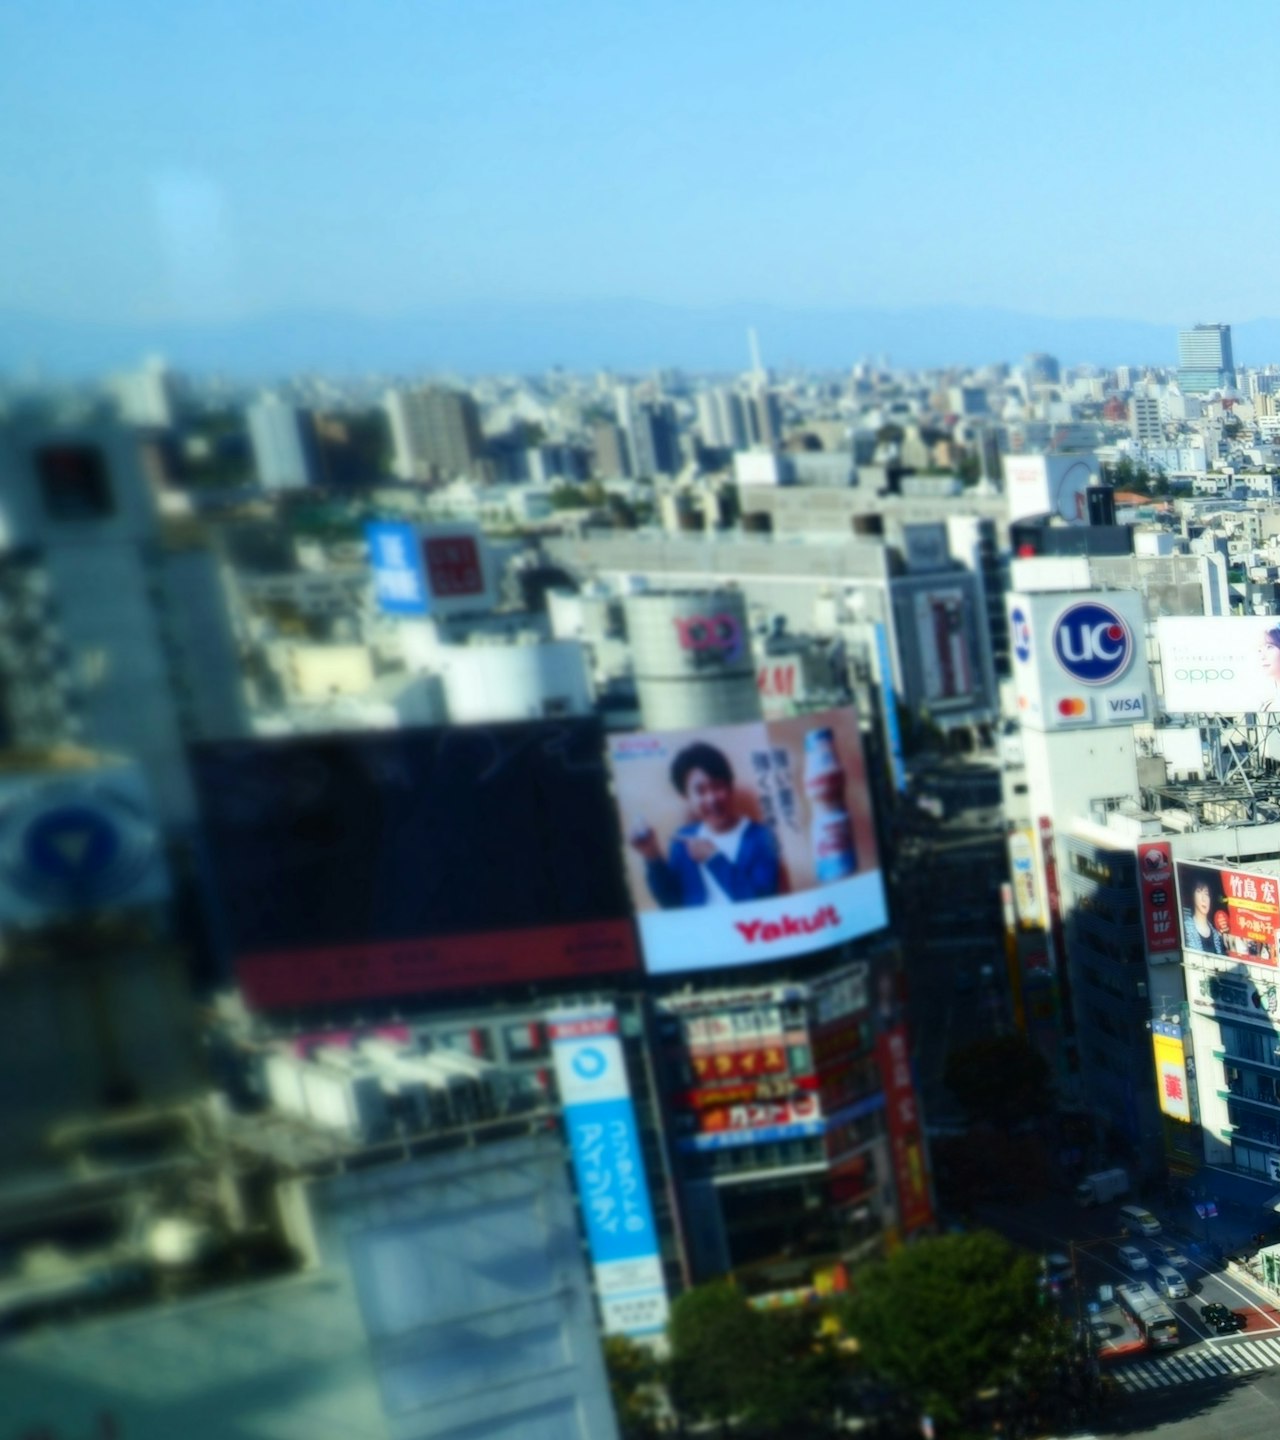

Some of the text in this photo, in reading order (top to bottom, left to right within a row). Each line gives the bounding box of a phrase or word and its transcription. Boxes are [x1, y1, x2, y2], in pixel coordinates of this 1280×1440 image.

[1174, 667, 1234, 685] oppo
[1110, 698, 1142, 713] VISA
[1229, 875, 1257, 900] 竹島
[734, 905, 841, 944] Yakult
